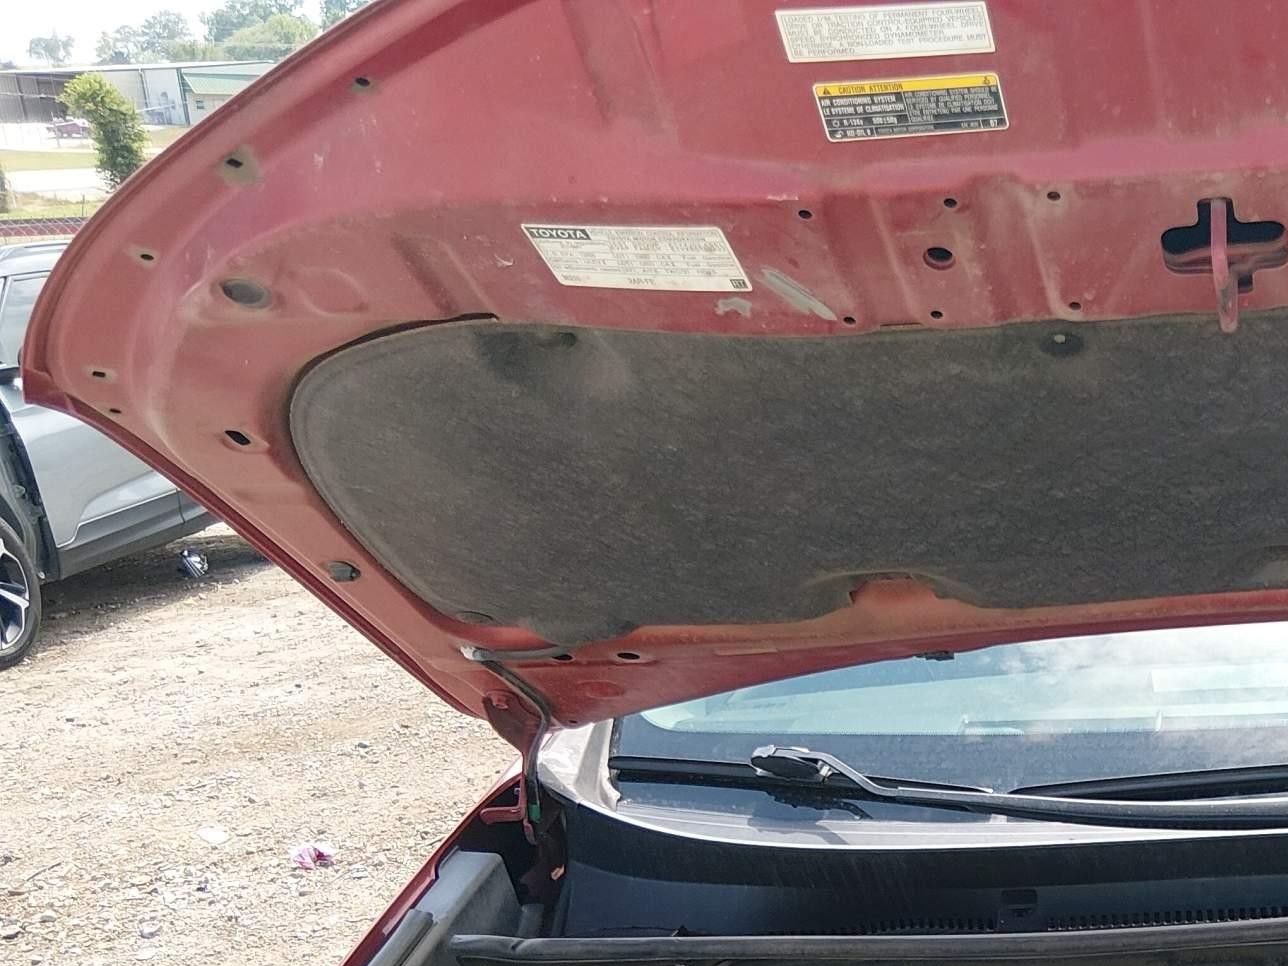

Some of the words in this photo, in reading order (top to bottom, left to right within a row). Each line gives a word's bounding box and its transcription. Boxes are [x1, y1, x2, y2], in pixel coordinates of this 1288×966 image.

[838, 86, 866, 94] CAUTION
[869, 84, 904, 92] ATTENTION
[528, 229, 588, 239] TOYOTA
